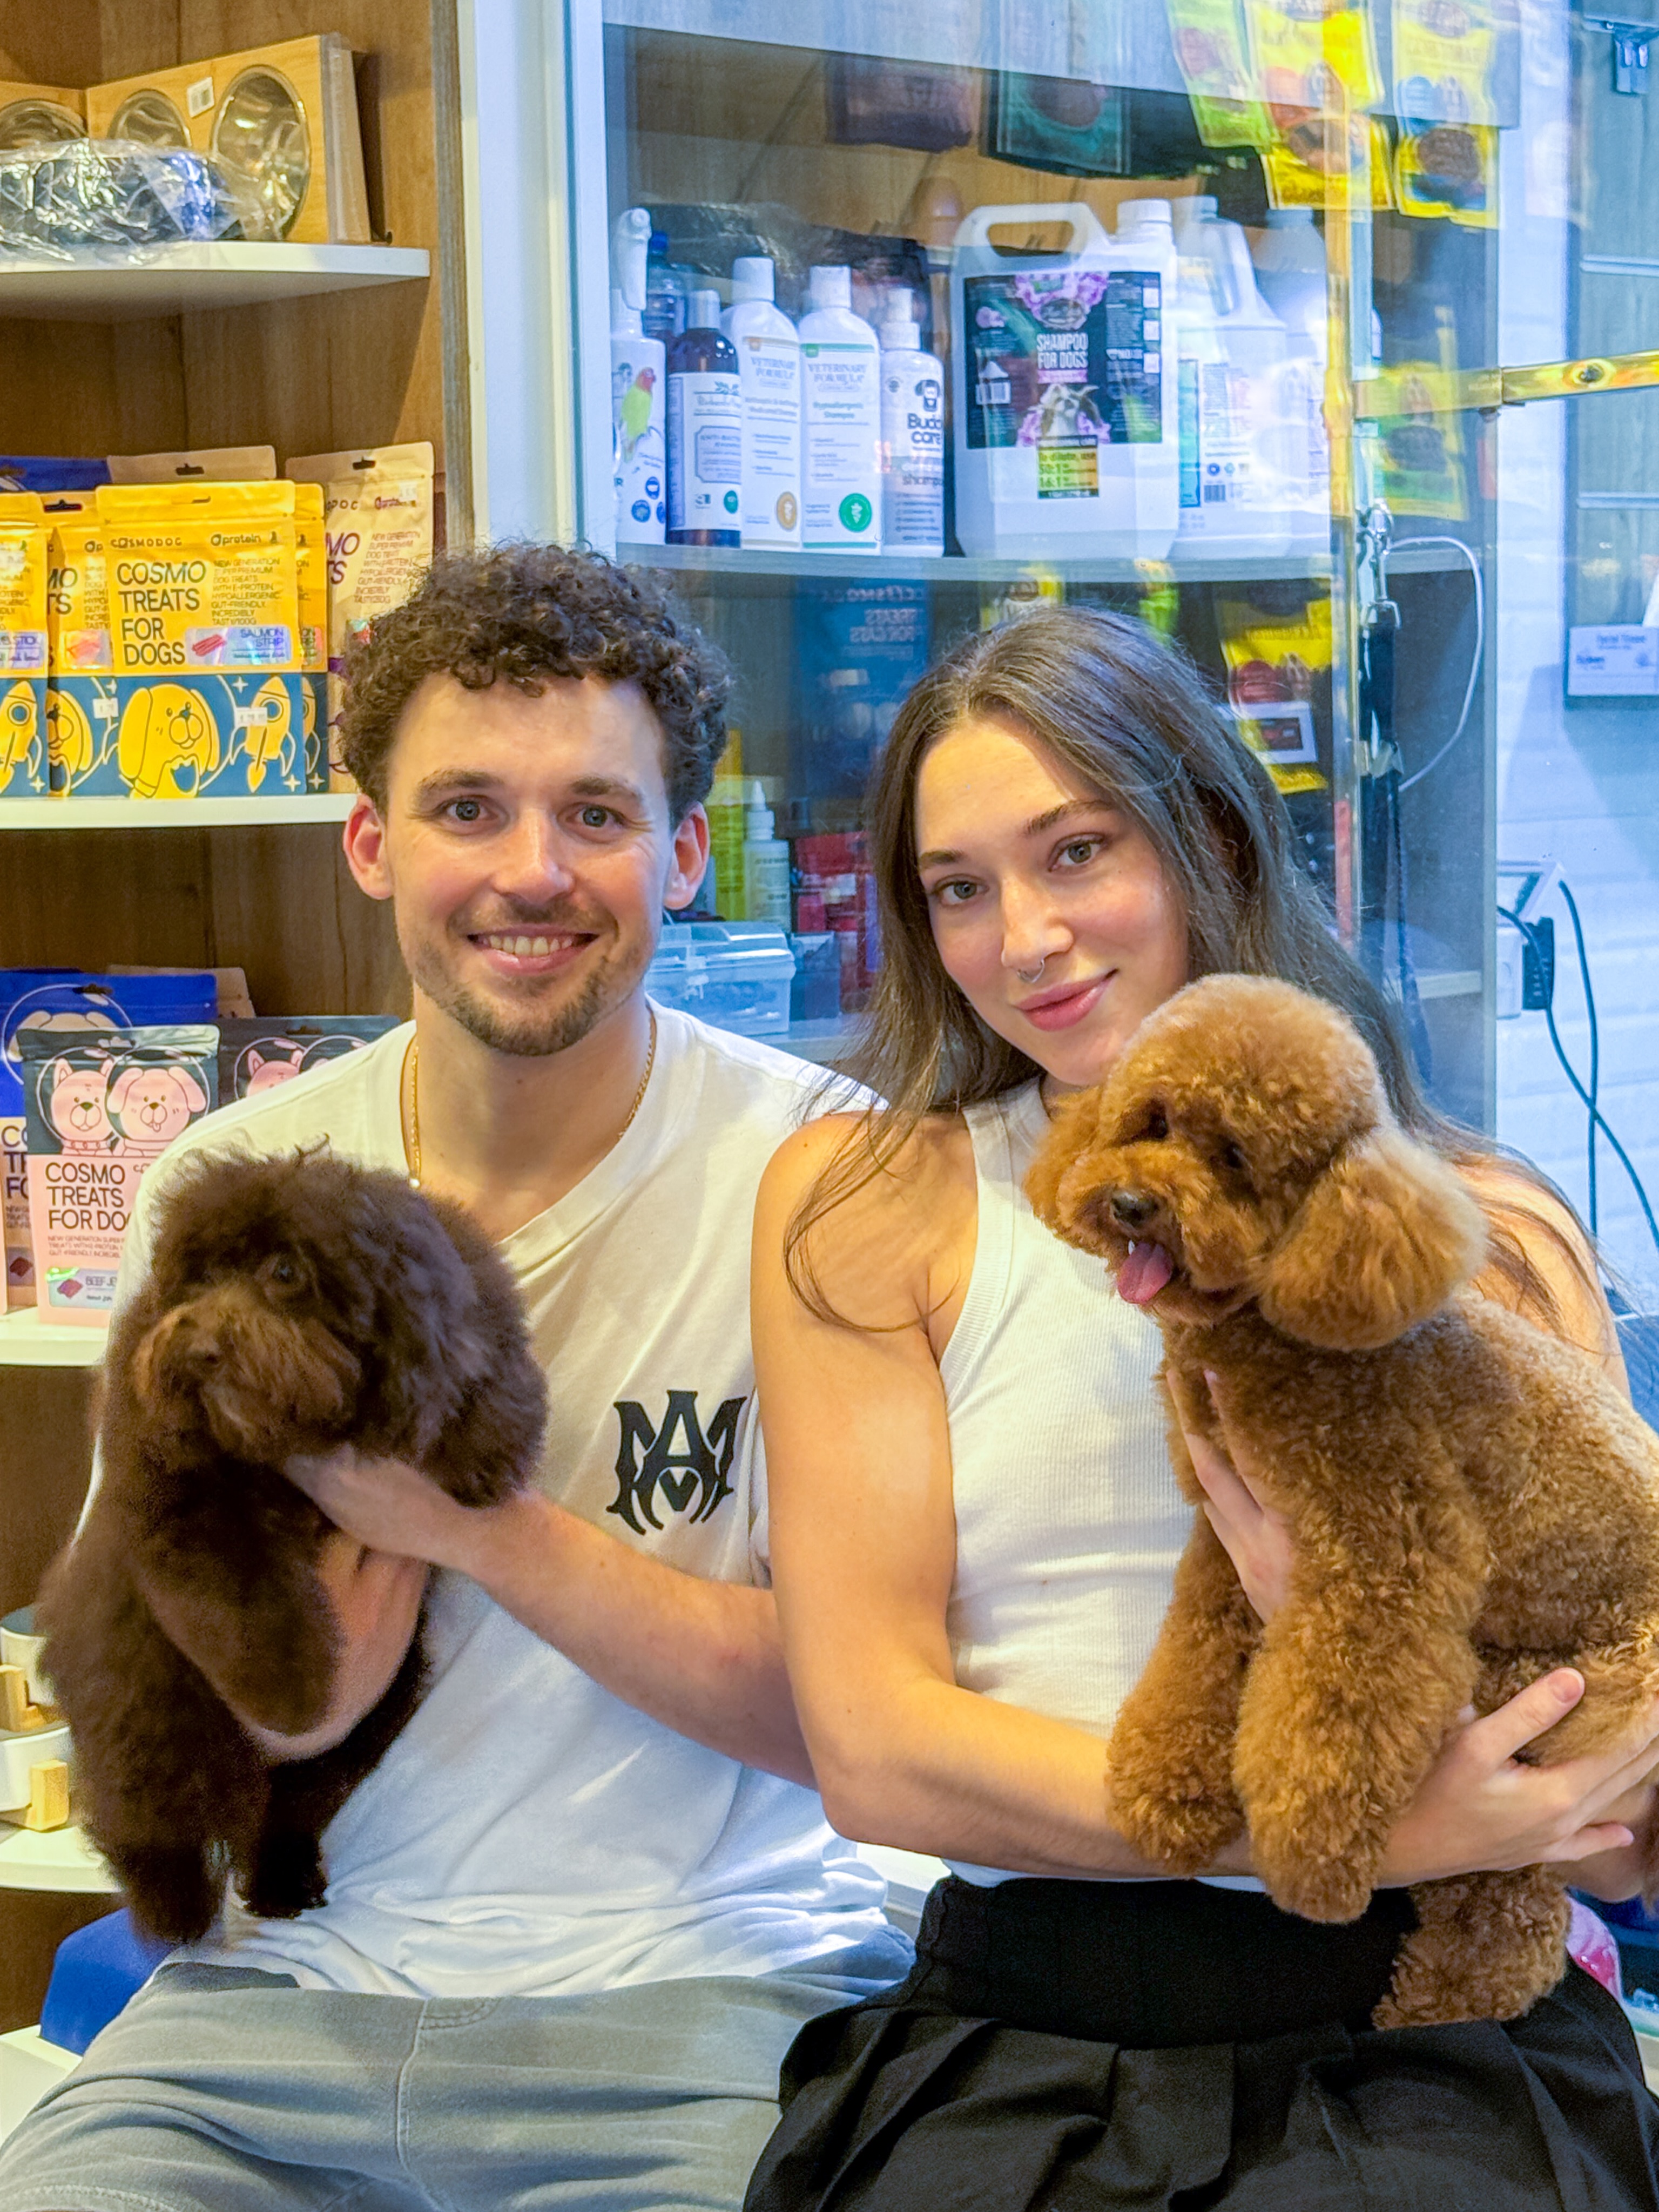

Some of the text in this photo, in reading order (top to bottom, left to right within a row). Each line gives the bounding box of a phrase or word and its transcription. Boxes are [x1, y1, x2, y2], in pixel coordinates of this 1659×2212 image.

[1036, 333, 1088, 351] SHAMPOO
[1038, 352, 1058, 369] FOR
[1059, 351, 1088, 369] DOGS
[117, 561, 206, 586] COSMO
[117, 588, 200, 613] TREATS
[121, 617, 165, 641] FOR
[123, 642, 185, 667] DOGS
[45, 1162, 125, 1185] COSMO
[46, 1185, 124, 1208] TREATS
[49, 1208, 93, 1231] FOR
